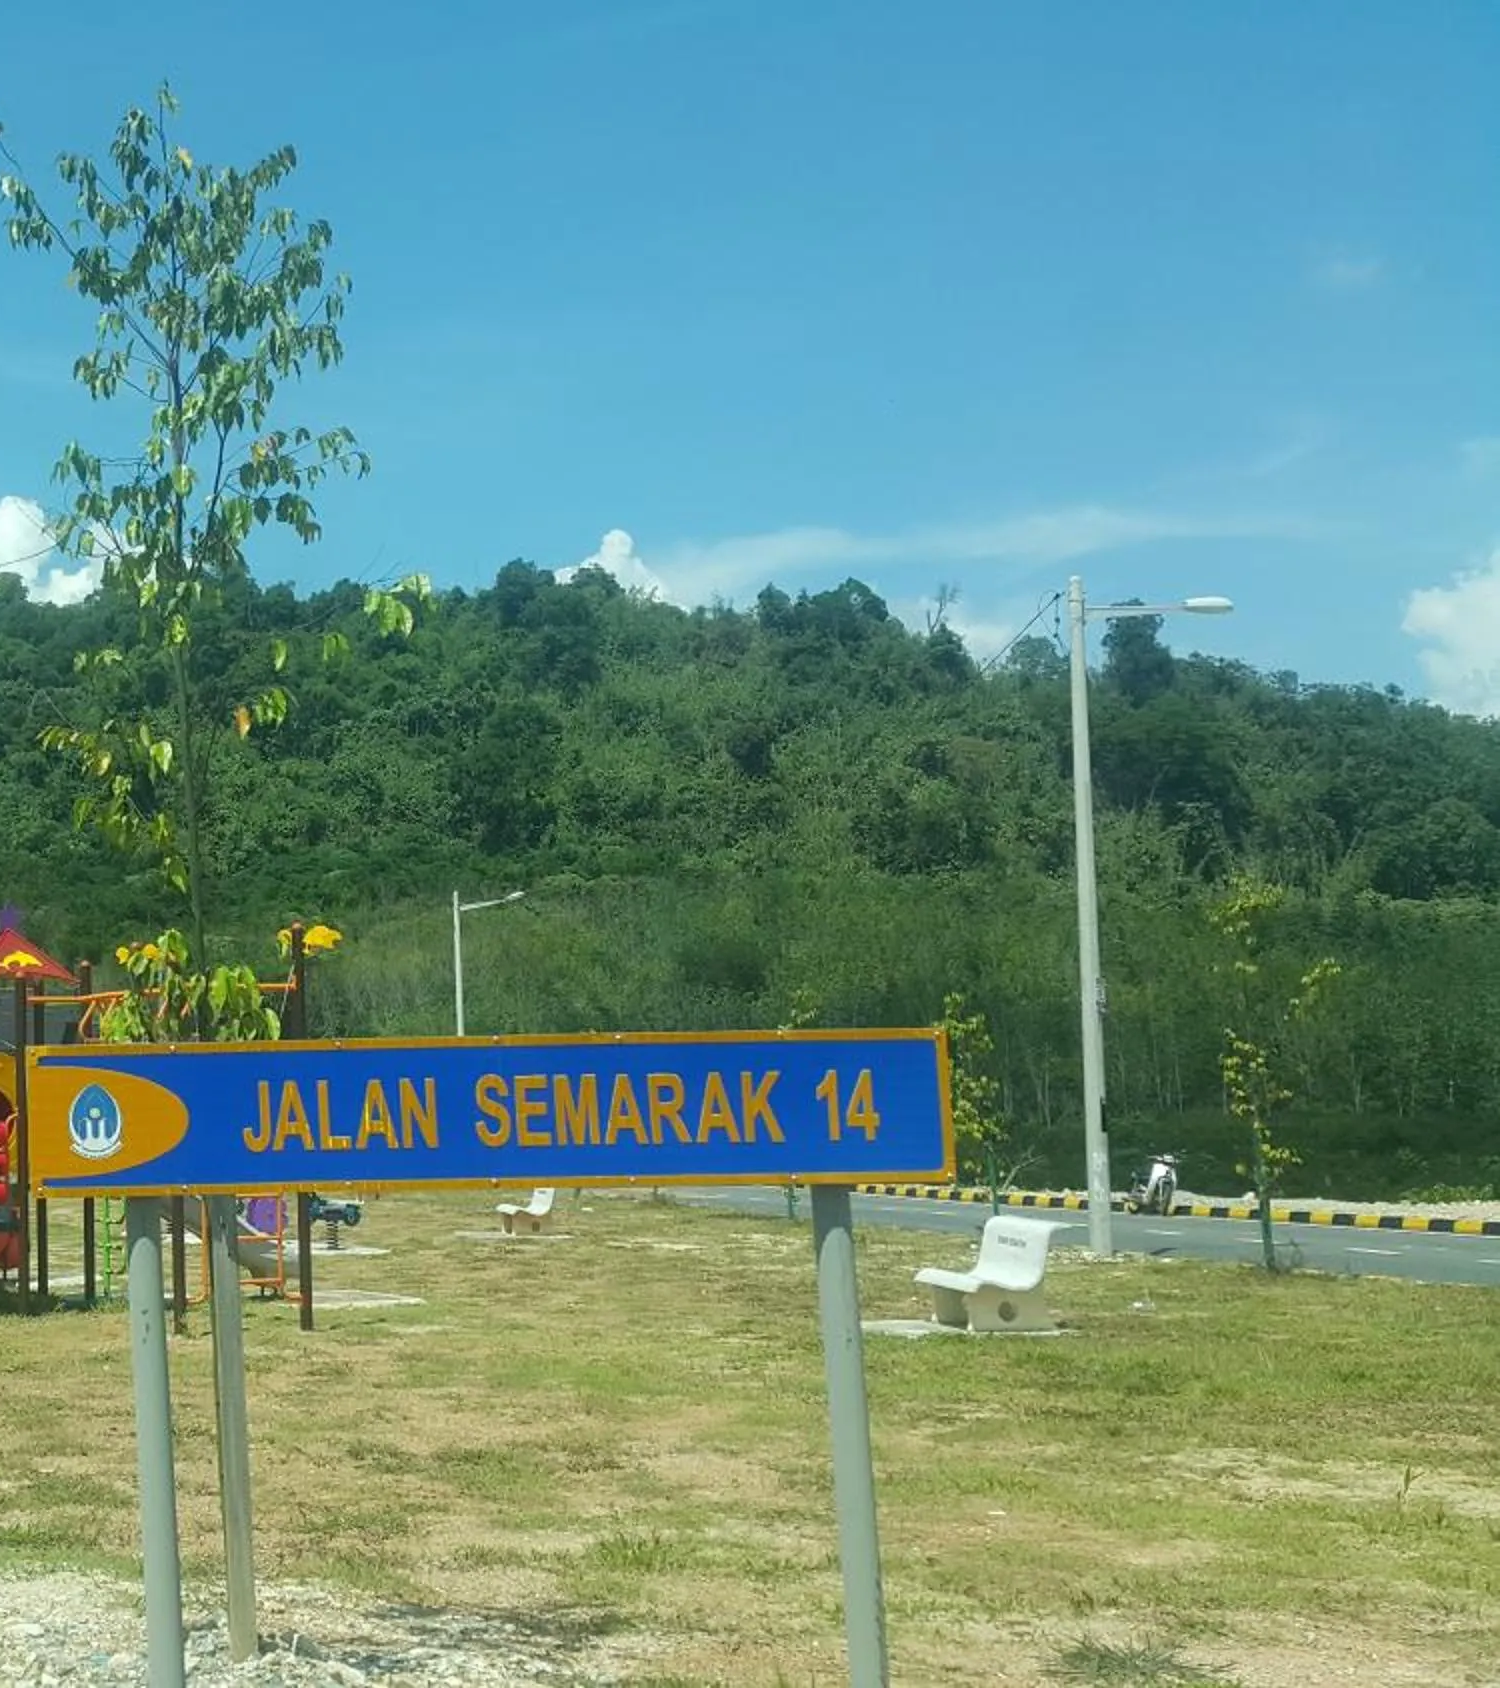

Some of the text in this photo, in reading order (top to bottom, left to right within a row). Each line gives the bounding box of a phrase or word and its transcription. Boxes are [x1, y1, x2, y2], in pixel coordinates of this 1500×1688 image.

[243, 1069, 880, 1152] JALAN SEMARAK 14
